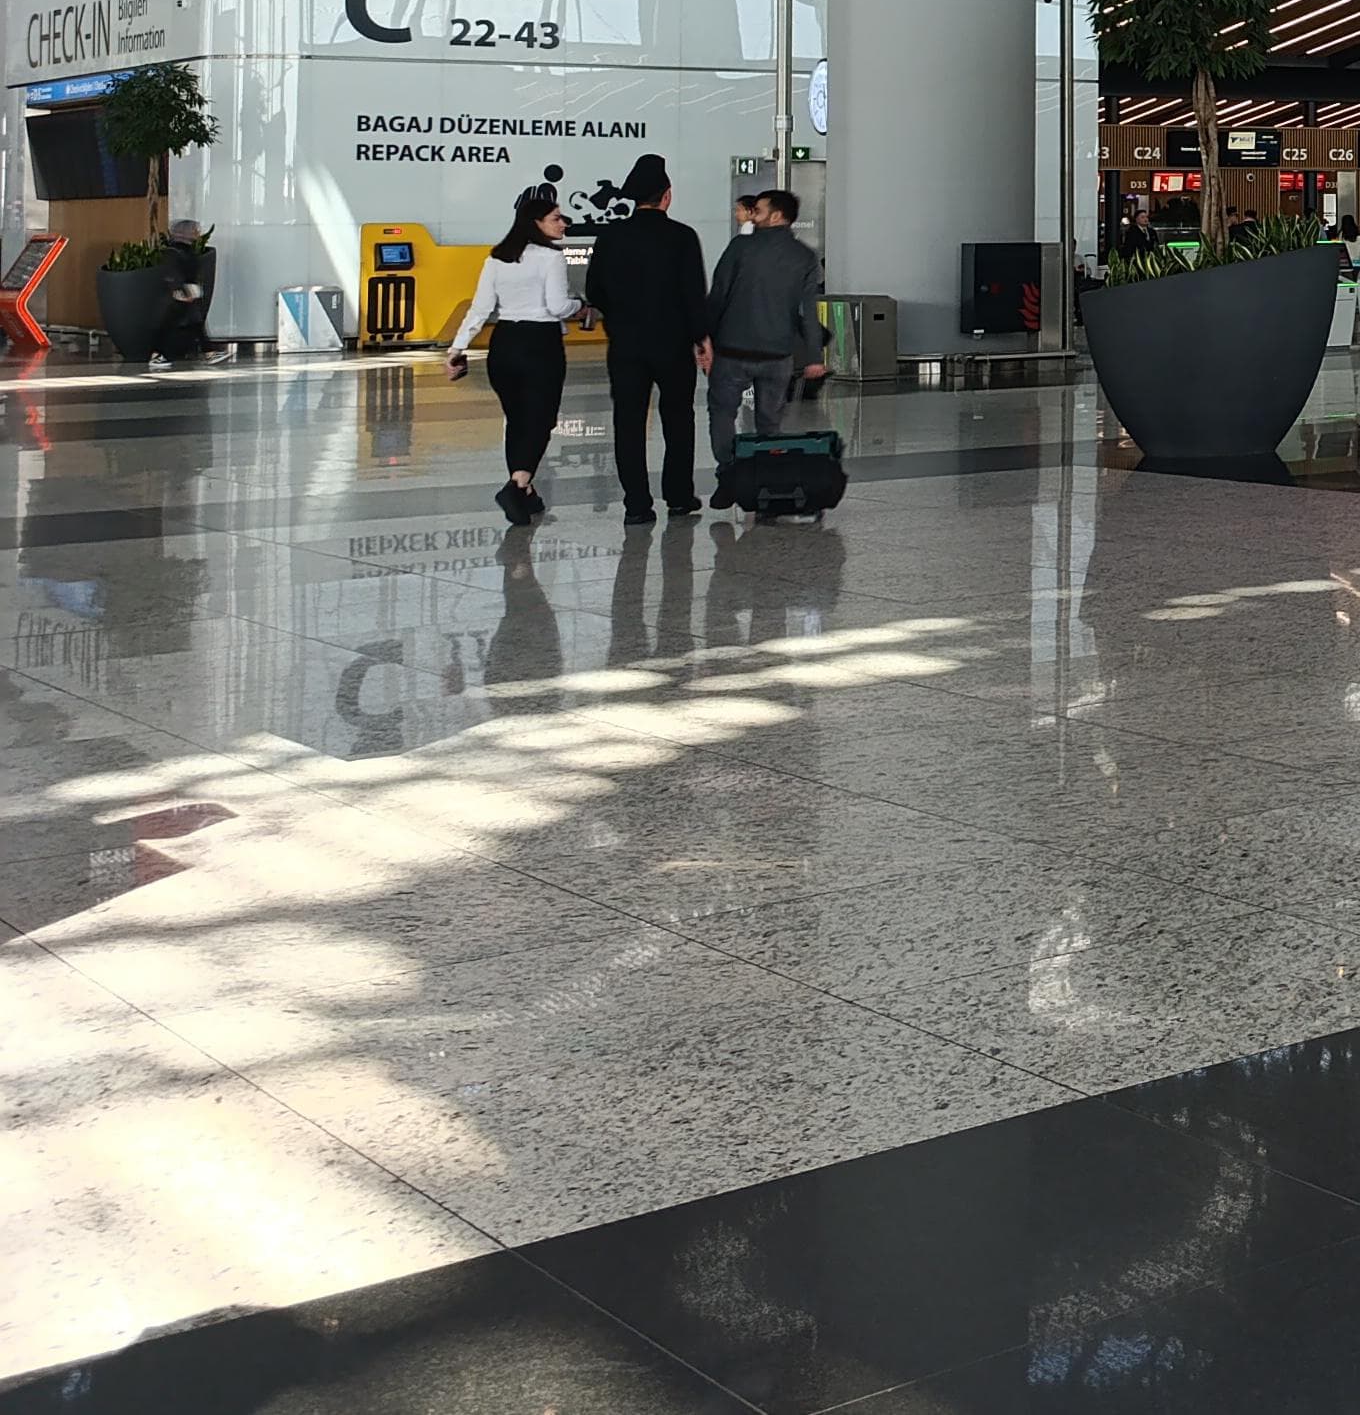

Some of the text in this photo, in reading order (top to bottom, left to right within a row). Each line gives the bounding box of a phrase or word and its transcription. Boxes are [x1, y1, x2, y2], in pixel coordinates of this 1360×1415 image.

[117, 25, 165, 55] Information
[450, 18, 560, 50] 22-43
[356, 113, 646, 139] BAGAJ DÜZENLEME ALANI
[356, 143, 511, 163] REPACK AREA
[1133, 146, 1161, 160] C24
[1282, 148, 1308, 161] C25
[1329, 149, 1354, 161] C26
[1130, 181, 1147, 189] D35
